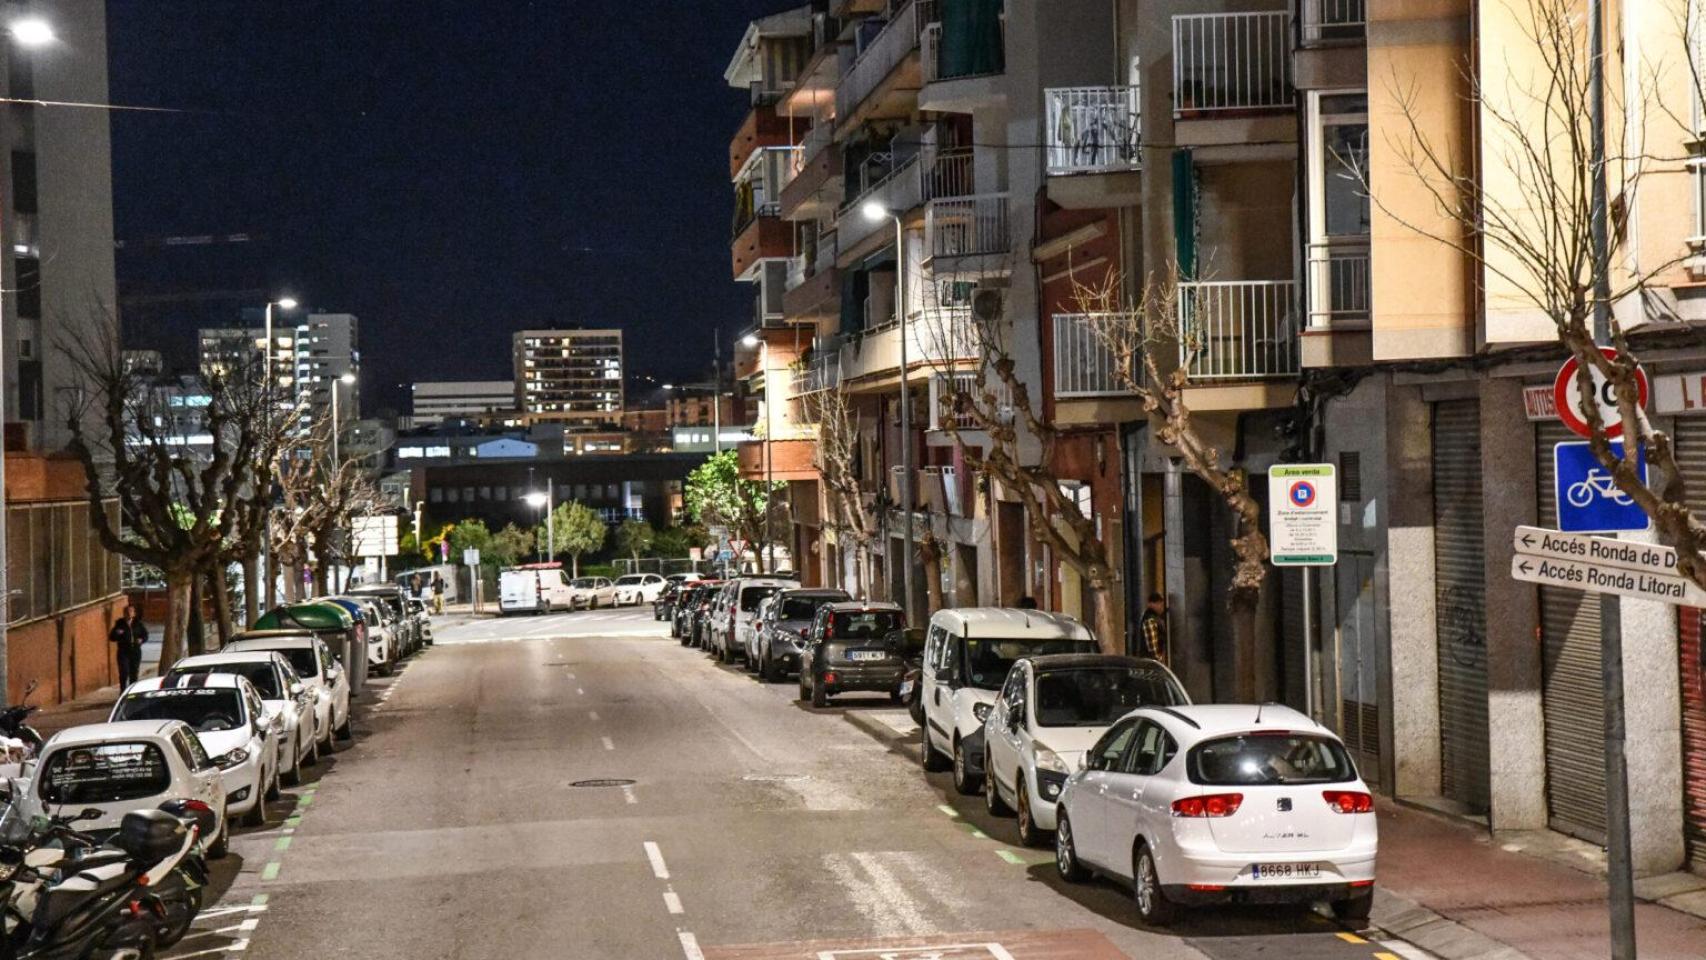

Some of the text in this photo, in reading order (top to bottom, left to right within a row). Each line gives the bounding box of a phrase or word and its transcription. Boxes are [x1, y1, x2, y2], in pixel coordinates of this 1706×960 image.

[1541, 534, 1678, 568] Accés Ronda de D
[1538, 560, 1686, 598] Accés Ronda Litoral
[1296, 864, 1319, 876] HKJ
